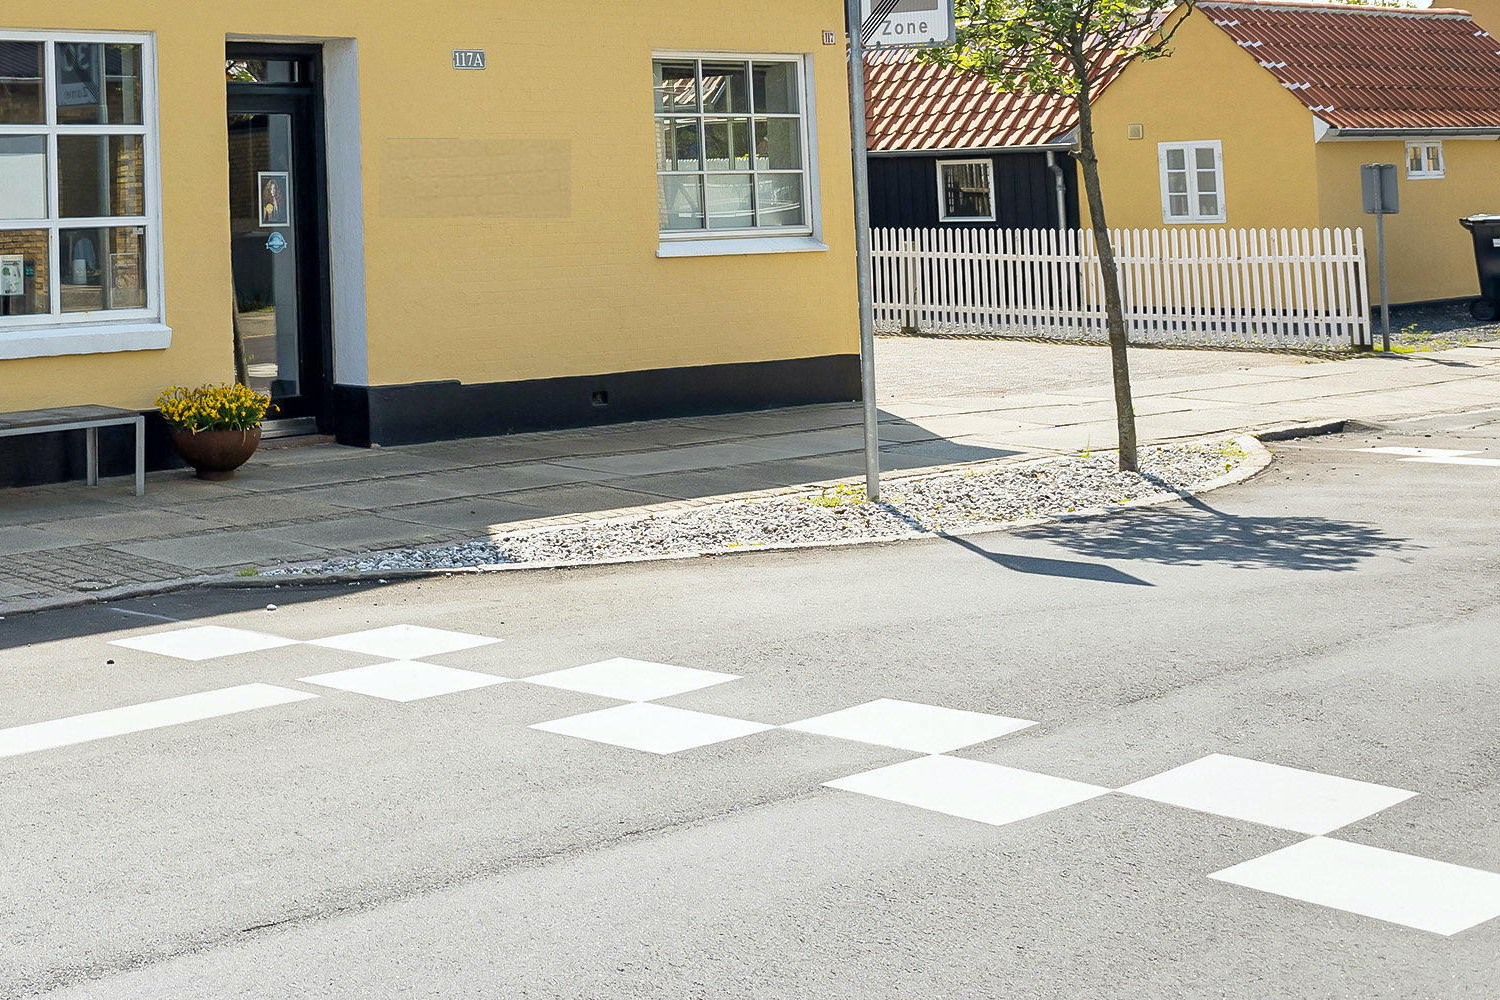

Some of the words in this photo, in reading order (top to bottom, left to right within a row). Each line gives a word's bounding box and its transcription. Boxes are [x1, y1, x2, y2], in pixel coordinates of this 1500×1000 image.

[882, 20, 928, 36] Zone
[825, 32, 834, 43] 117
[455, 52, 484, 67] 117A
